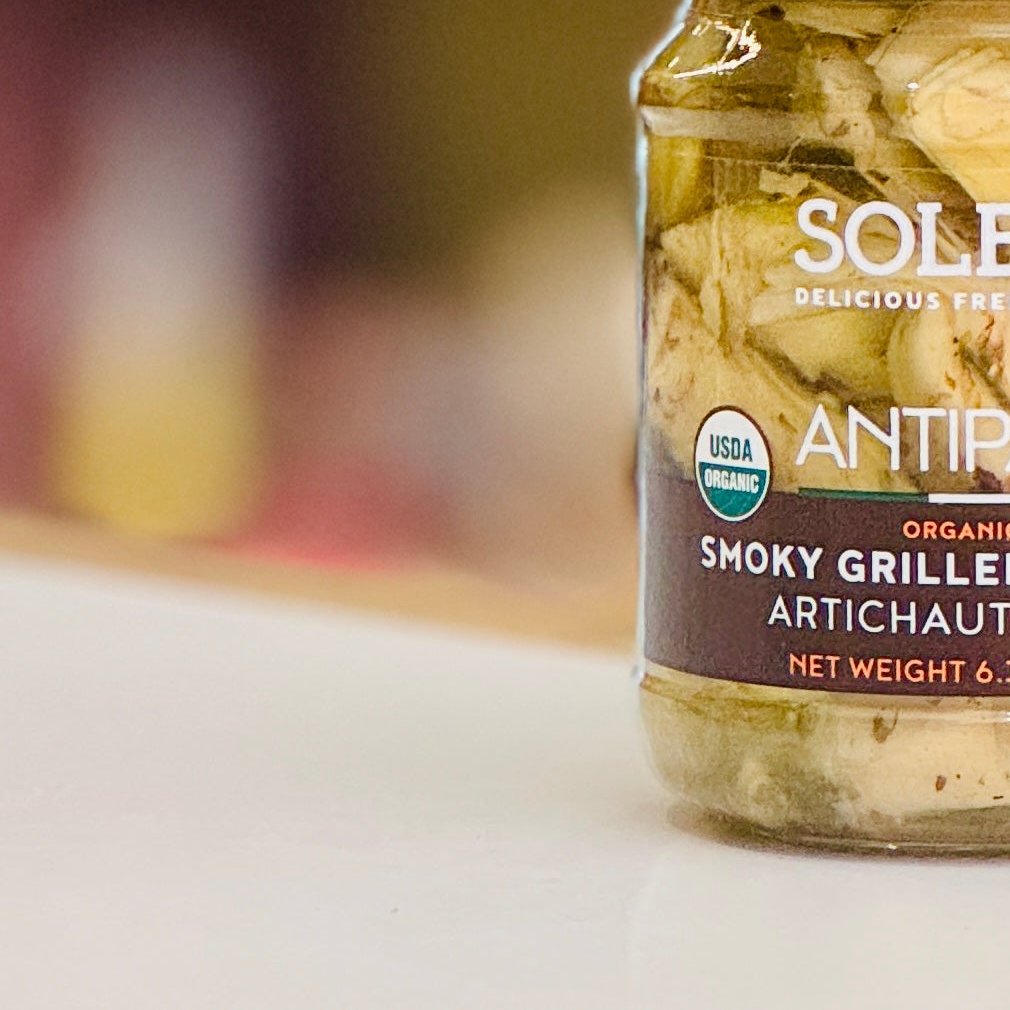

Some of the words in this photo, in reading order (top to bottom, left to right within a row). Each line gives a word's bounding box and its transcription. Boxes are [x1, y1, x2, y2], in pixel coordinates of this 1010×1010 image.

[794, 286, 941, 311] DELICIOUS
[710, 434, 753, 462] USDA
[704, 468, 760, 494] ORGANIC
[700, 534, 823, 580] SMOKY
[789, 653, 841, 679] NET
[848, 657, 966, 683] WEIGHT
